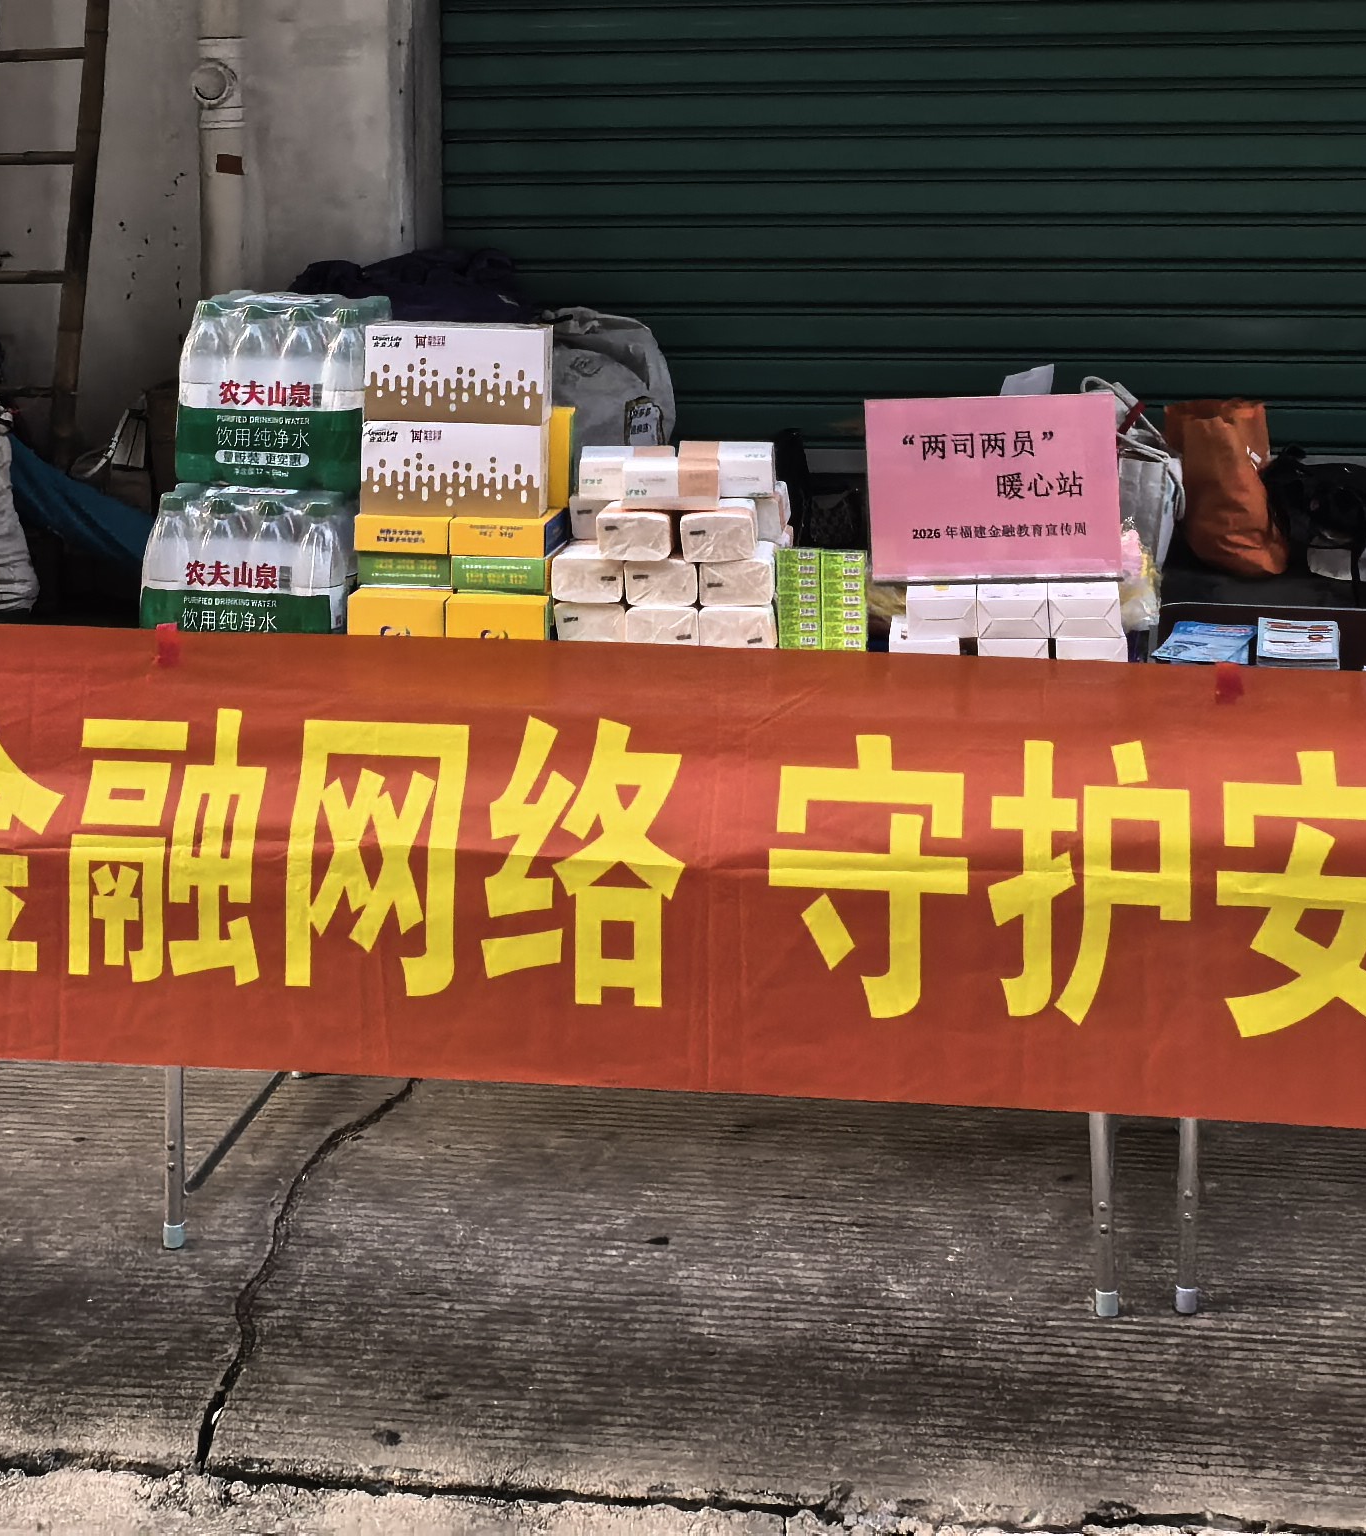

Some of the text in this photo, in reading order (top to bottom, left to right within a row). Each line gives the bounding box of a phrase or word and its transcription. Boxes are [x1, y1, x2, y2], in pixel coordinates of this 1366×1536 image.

[219, 379, 311, 407] 农夫山泉
[217, 415, 310, 425] PURIFIED DRINKING WATER
[216, 426, 310, 449] 饮用纯净水
[996, 471, 1084, 500] 暖心站
[185, 560, 277, 589] 农夫山泉
[183, 596, 277, 607] PURIFIED DRINKING WATER
[182, 608, 277, 632] 饮用纯净水
